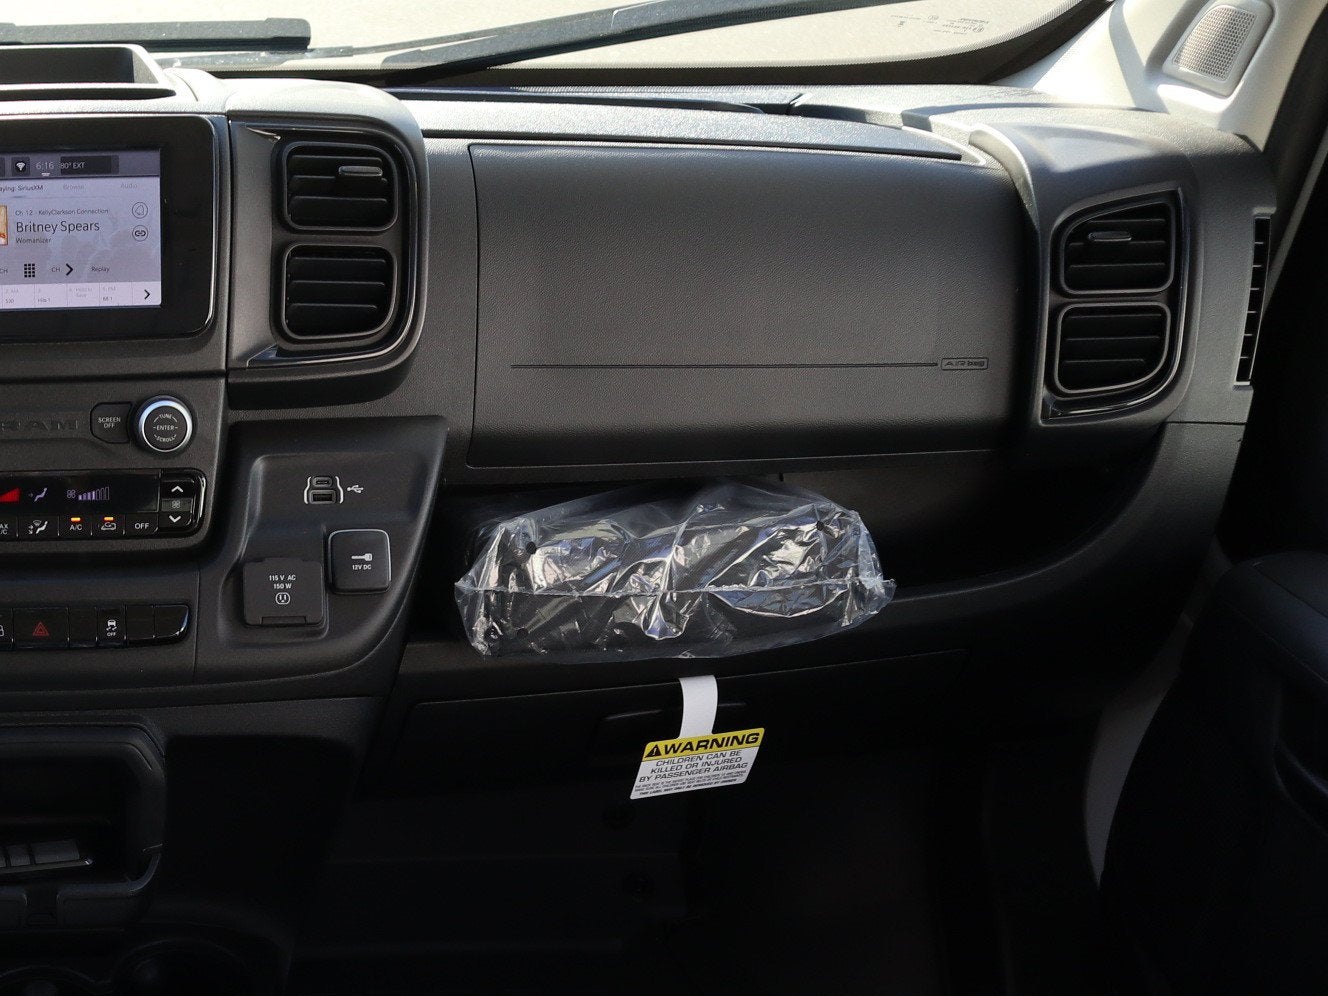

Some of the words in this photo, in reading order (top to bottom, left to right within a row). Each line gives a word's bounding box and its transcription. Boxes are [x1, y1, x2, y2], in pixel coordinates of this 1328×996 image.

[35, 162, 54, 170] 6:16
[16, 222, 58, 234] Britney
[60, 221, 100, 233] Spears
[664, 732, 760, 755] WARNING
[650, 764, 683, 775] KILLED
[701, 757, 743, 768] INJURED
[656, 755, 704, 767] CHILDREN
[706, 752, 728, 760] CAN
[639, 775, 654, 783] BY
[655, 768, 711, 780] PASSENGER
[713, 762, 748, 773] AIRBAG
